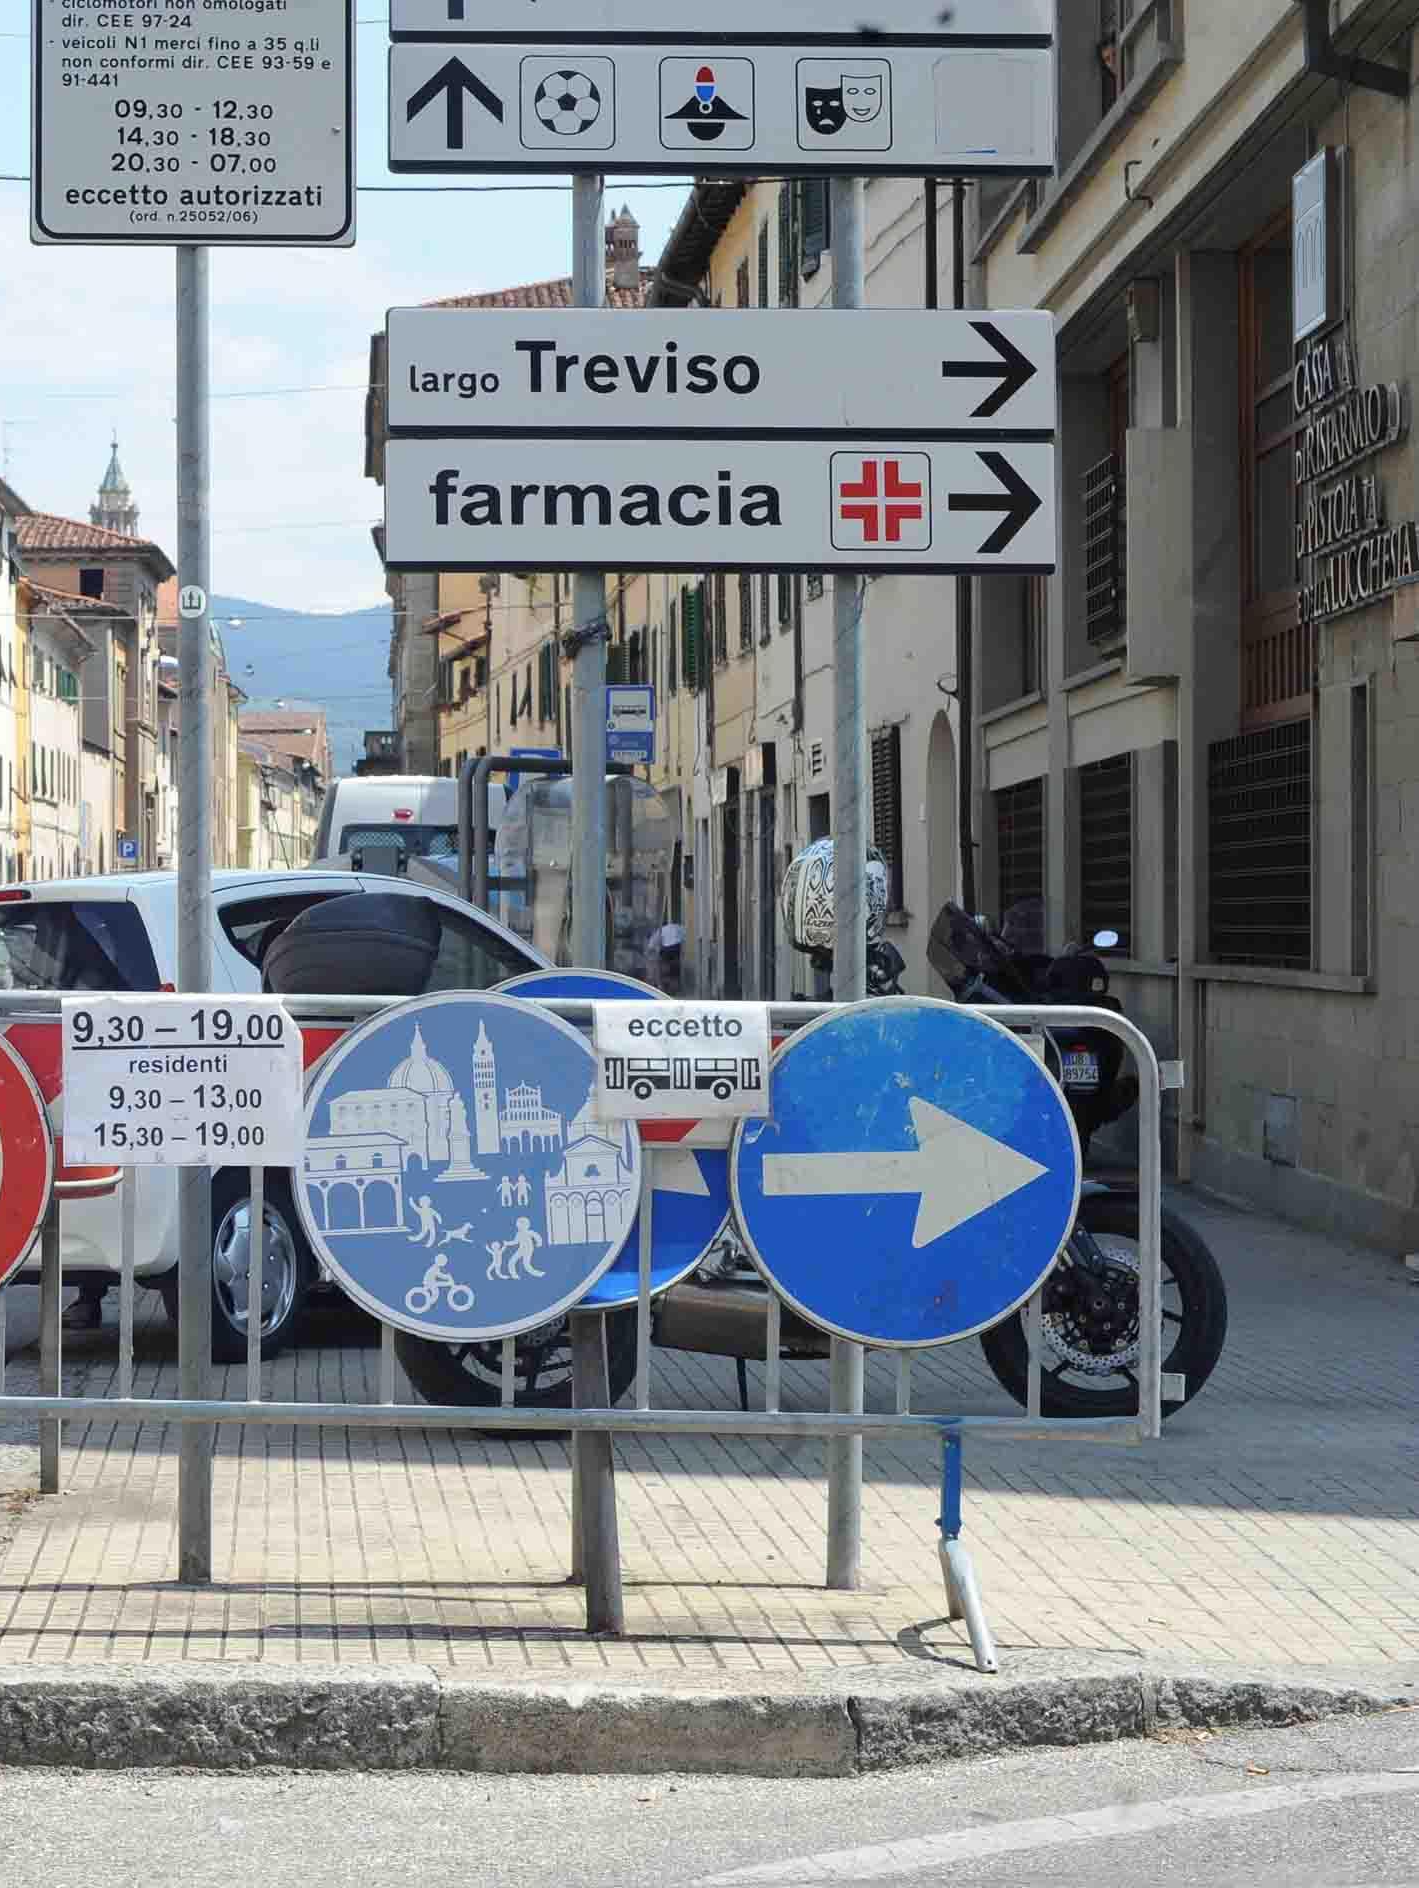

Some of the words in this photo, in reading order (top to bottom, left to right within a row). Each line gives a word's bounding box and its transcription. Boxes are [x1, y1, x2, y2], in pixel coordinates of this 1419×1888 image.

[62, 0, 157, 9] ciclomotori
[165, 0, 195, 9] non
[202, 0, 287, 13] omologati
[62, 14, 89, 28] dir.
[97, 14, 134, 28] CEE
[142, 14, 191, 28] 97-24
[62, 36, 116, 49] veicoli
[125, 36, 146, 49] N1
[154, 37, 200, 50] merci
[208, 37, 240, 50] fino
[247, 40, 257, 50] a
[264, 37, 287, 51] 35
[294, 37, 319, 53] q.li
[62, 57, 93, 68] non
[100, 55, 175, 68] conformi
[182, 55, 209, 69] dir.
[217, 56, 254, 69] CEE
[262, 56, 314, 70] 93-59
[321, 60, 331, 70] e
[62, 73, 118, 87] 91-441
[66, 185, 168, 205] eccetto
[180, 185, 322, 206] autorizzati
[410, 366, 500, 399] largo
[515, 340, 760, 395] Treviso
[1294, 341, 1334, 413] CASSA
[1306, 385, 1381, 475] RISPARMIO
[428, 469, 782, 527] farmacia
[1308, 475, 1358, 553] PISTOIA
[1330, 520, 1413, 612] LUCCHESIA
[122, 842, 135, 857] P
[72, 1011, 144, 1043] 9,30
[190, 1009, 283, 1043] 19,00
[628, 1015, 743, 1038] eccetto
[129, 1054, 227, 1073] residenti
[109, 1086, 161, 1112] 9,30
[193, 1085, 262, 1112] 13,00
[94, 1123, 164, 1151] 15,30
[195, 1122, 264, 1150] 19,00
